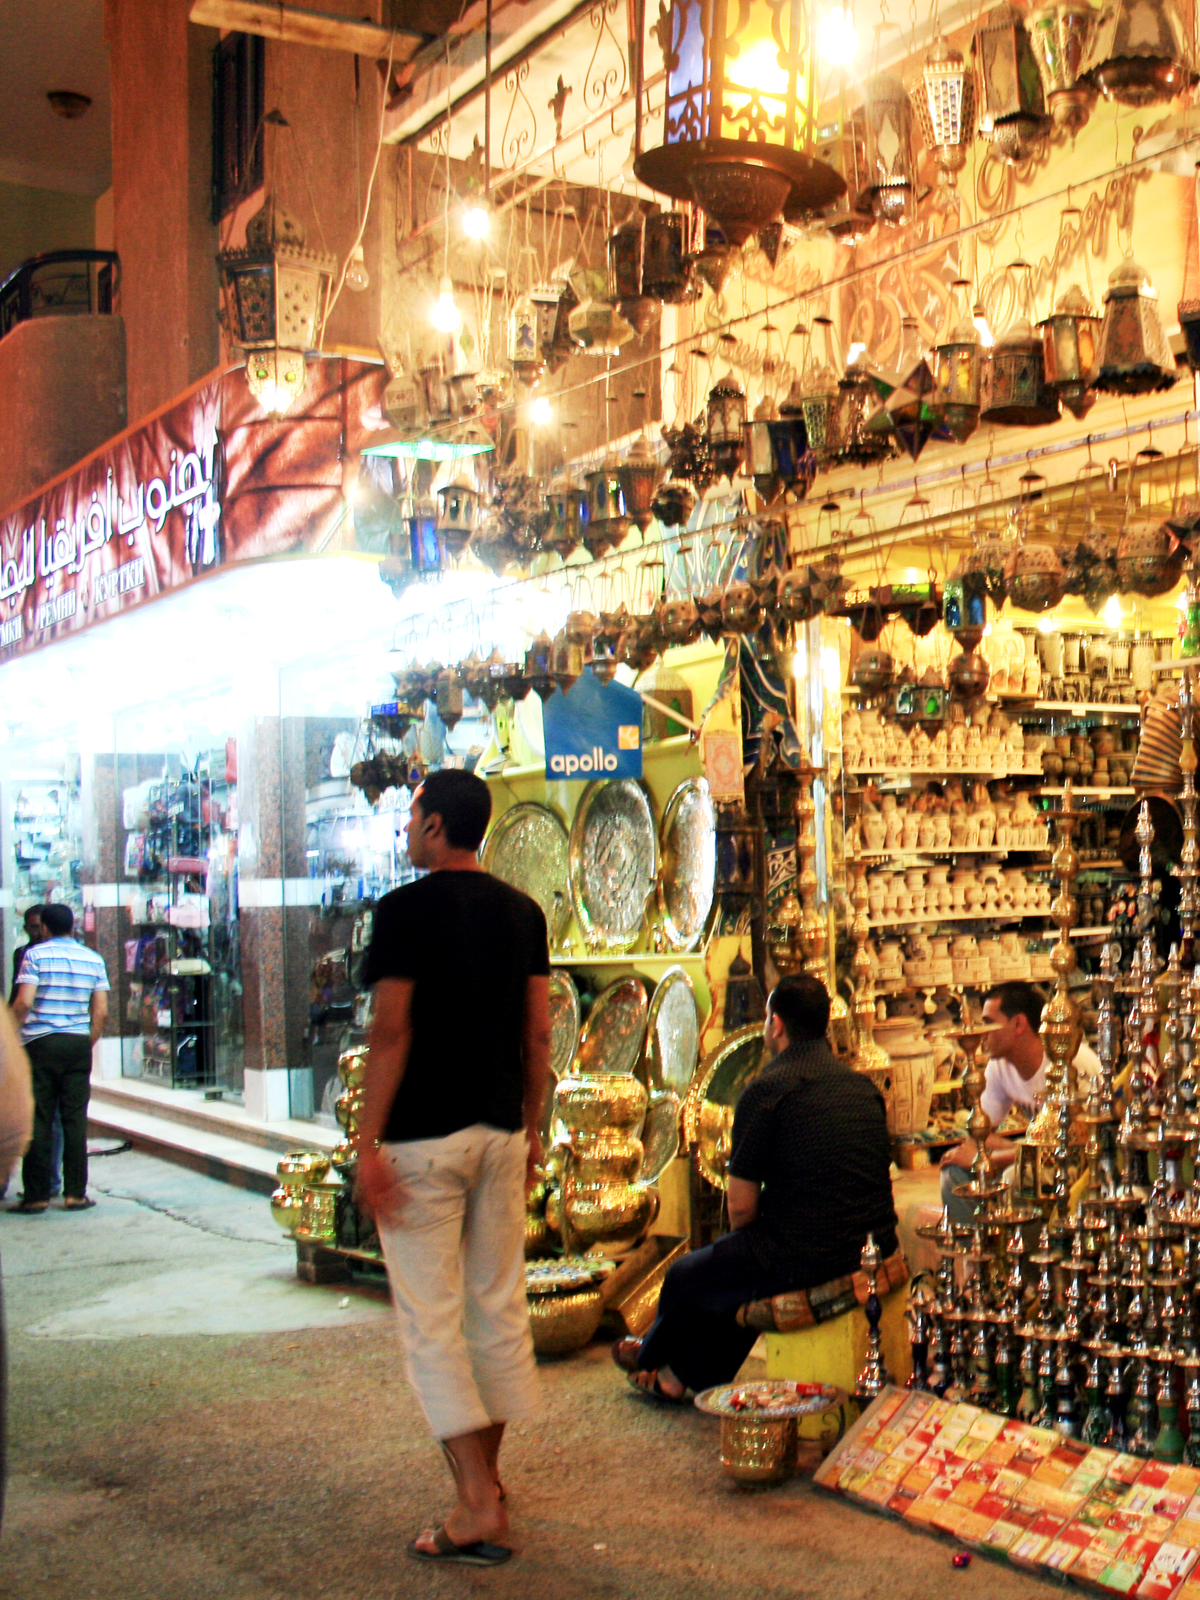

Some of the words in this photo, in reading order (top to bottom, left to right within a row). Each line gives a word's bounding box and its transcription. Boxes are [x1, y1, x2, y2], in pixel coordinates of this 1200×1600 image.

[117, 448, 212, 546] جنوب
[39, 588, 77, 631] РЕМНИ
[94, 554, 145, 605] КУРТКИ
[549, 745, 618, 777] apollo
